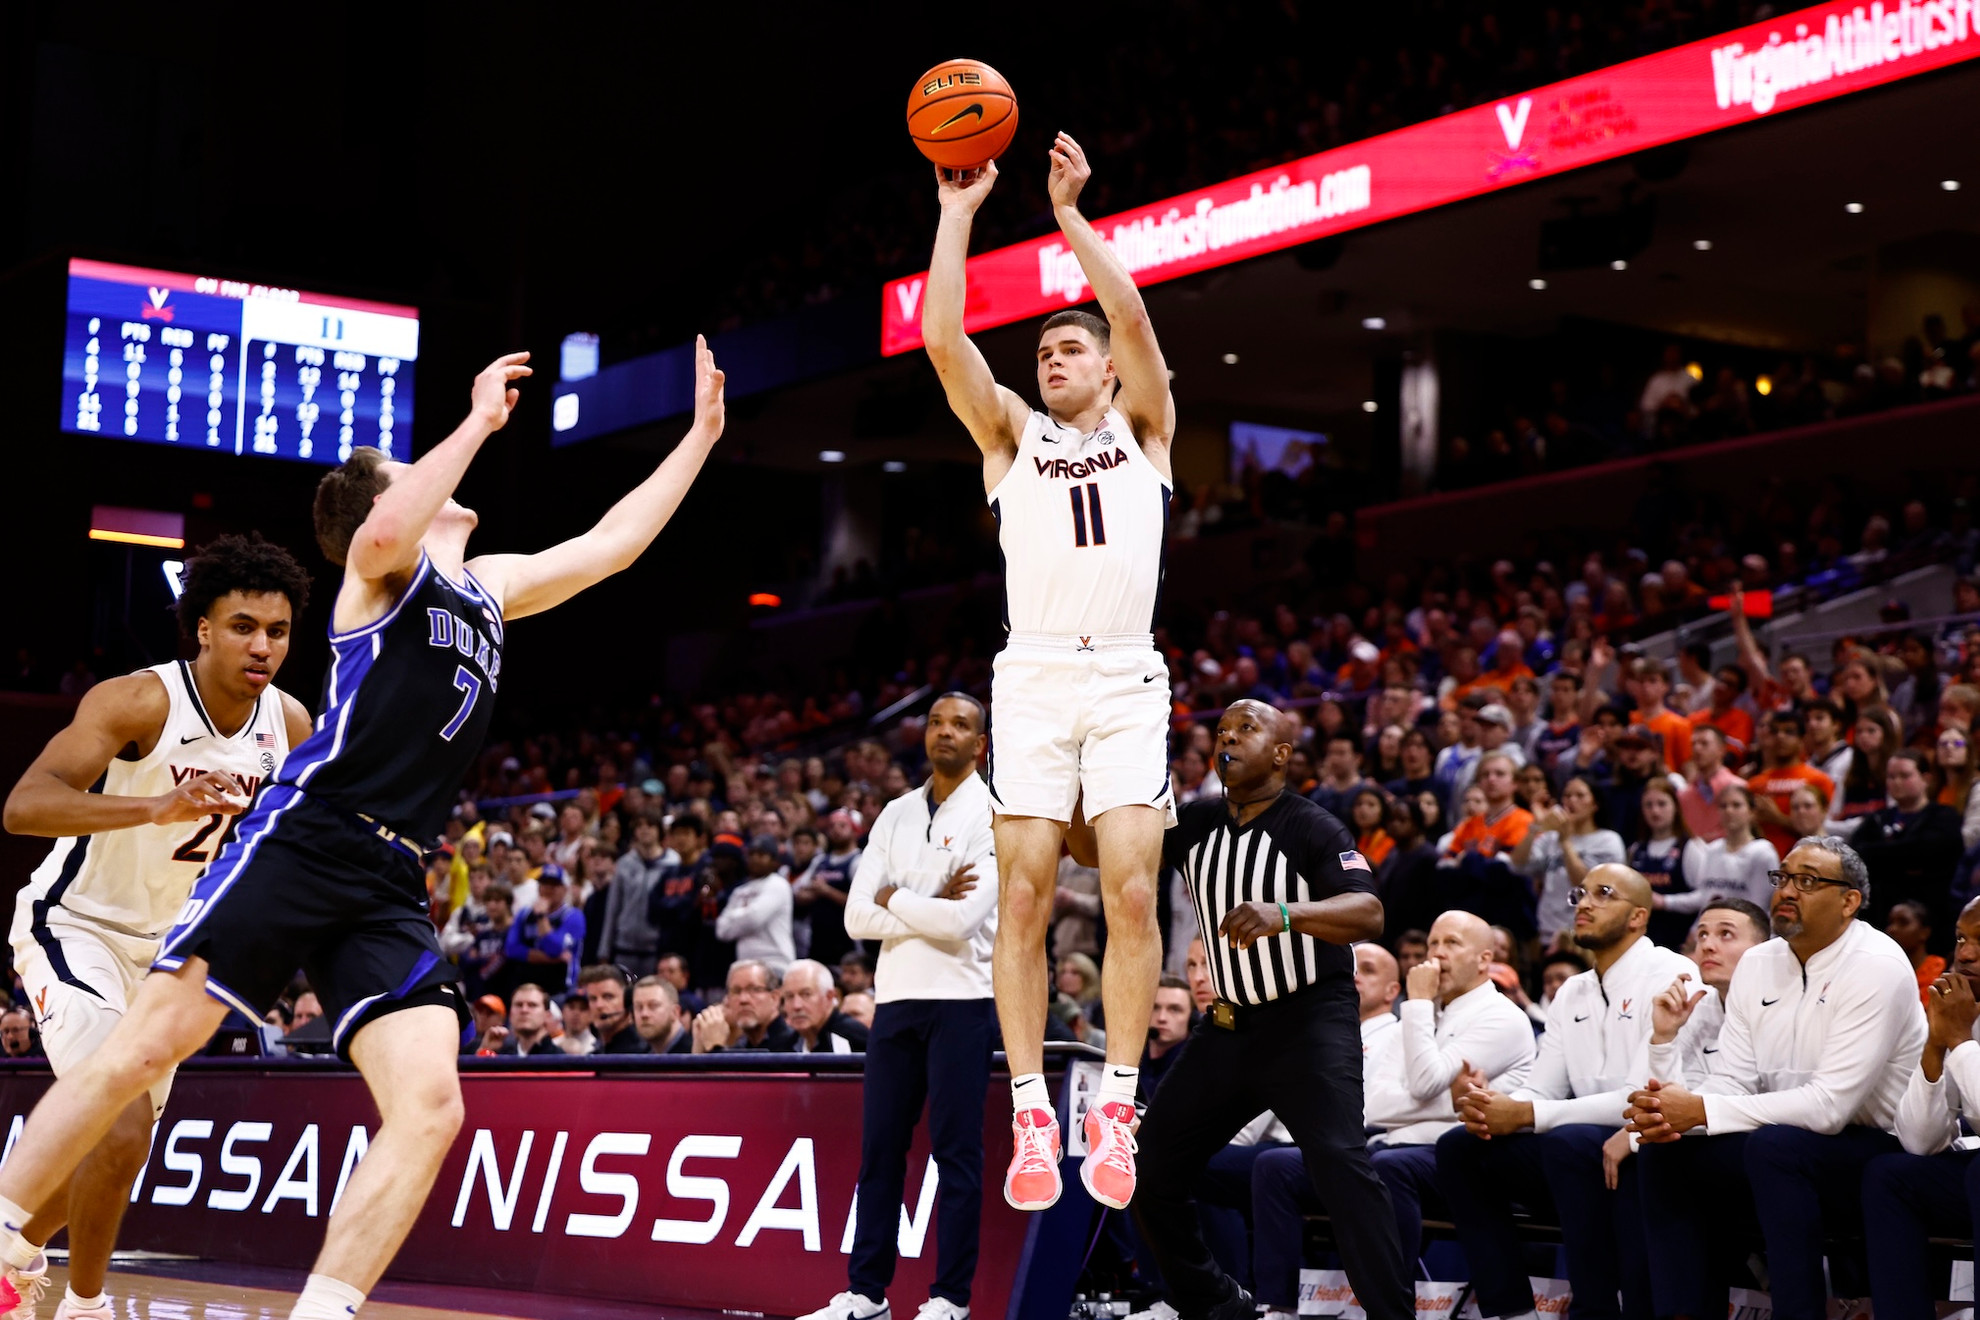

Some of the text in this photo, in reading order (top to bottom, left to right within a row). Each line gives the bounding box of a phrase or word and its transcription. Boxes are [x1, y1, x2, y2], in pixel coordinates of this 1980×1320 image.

[923, 72, 982, 97] ELITE
[1033, 447, 1129, 480] VIRGINIA
[1069, 482, 1107, 548] 11
[438, 664, 482, 742] 7
